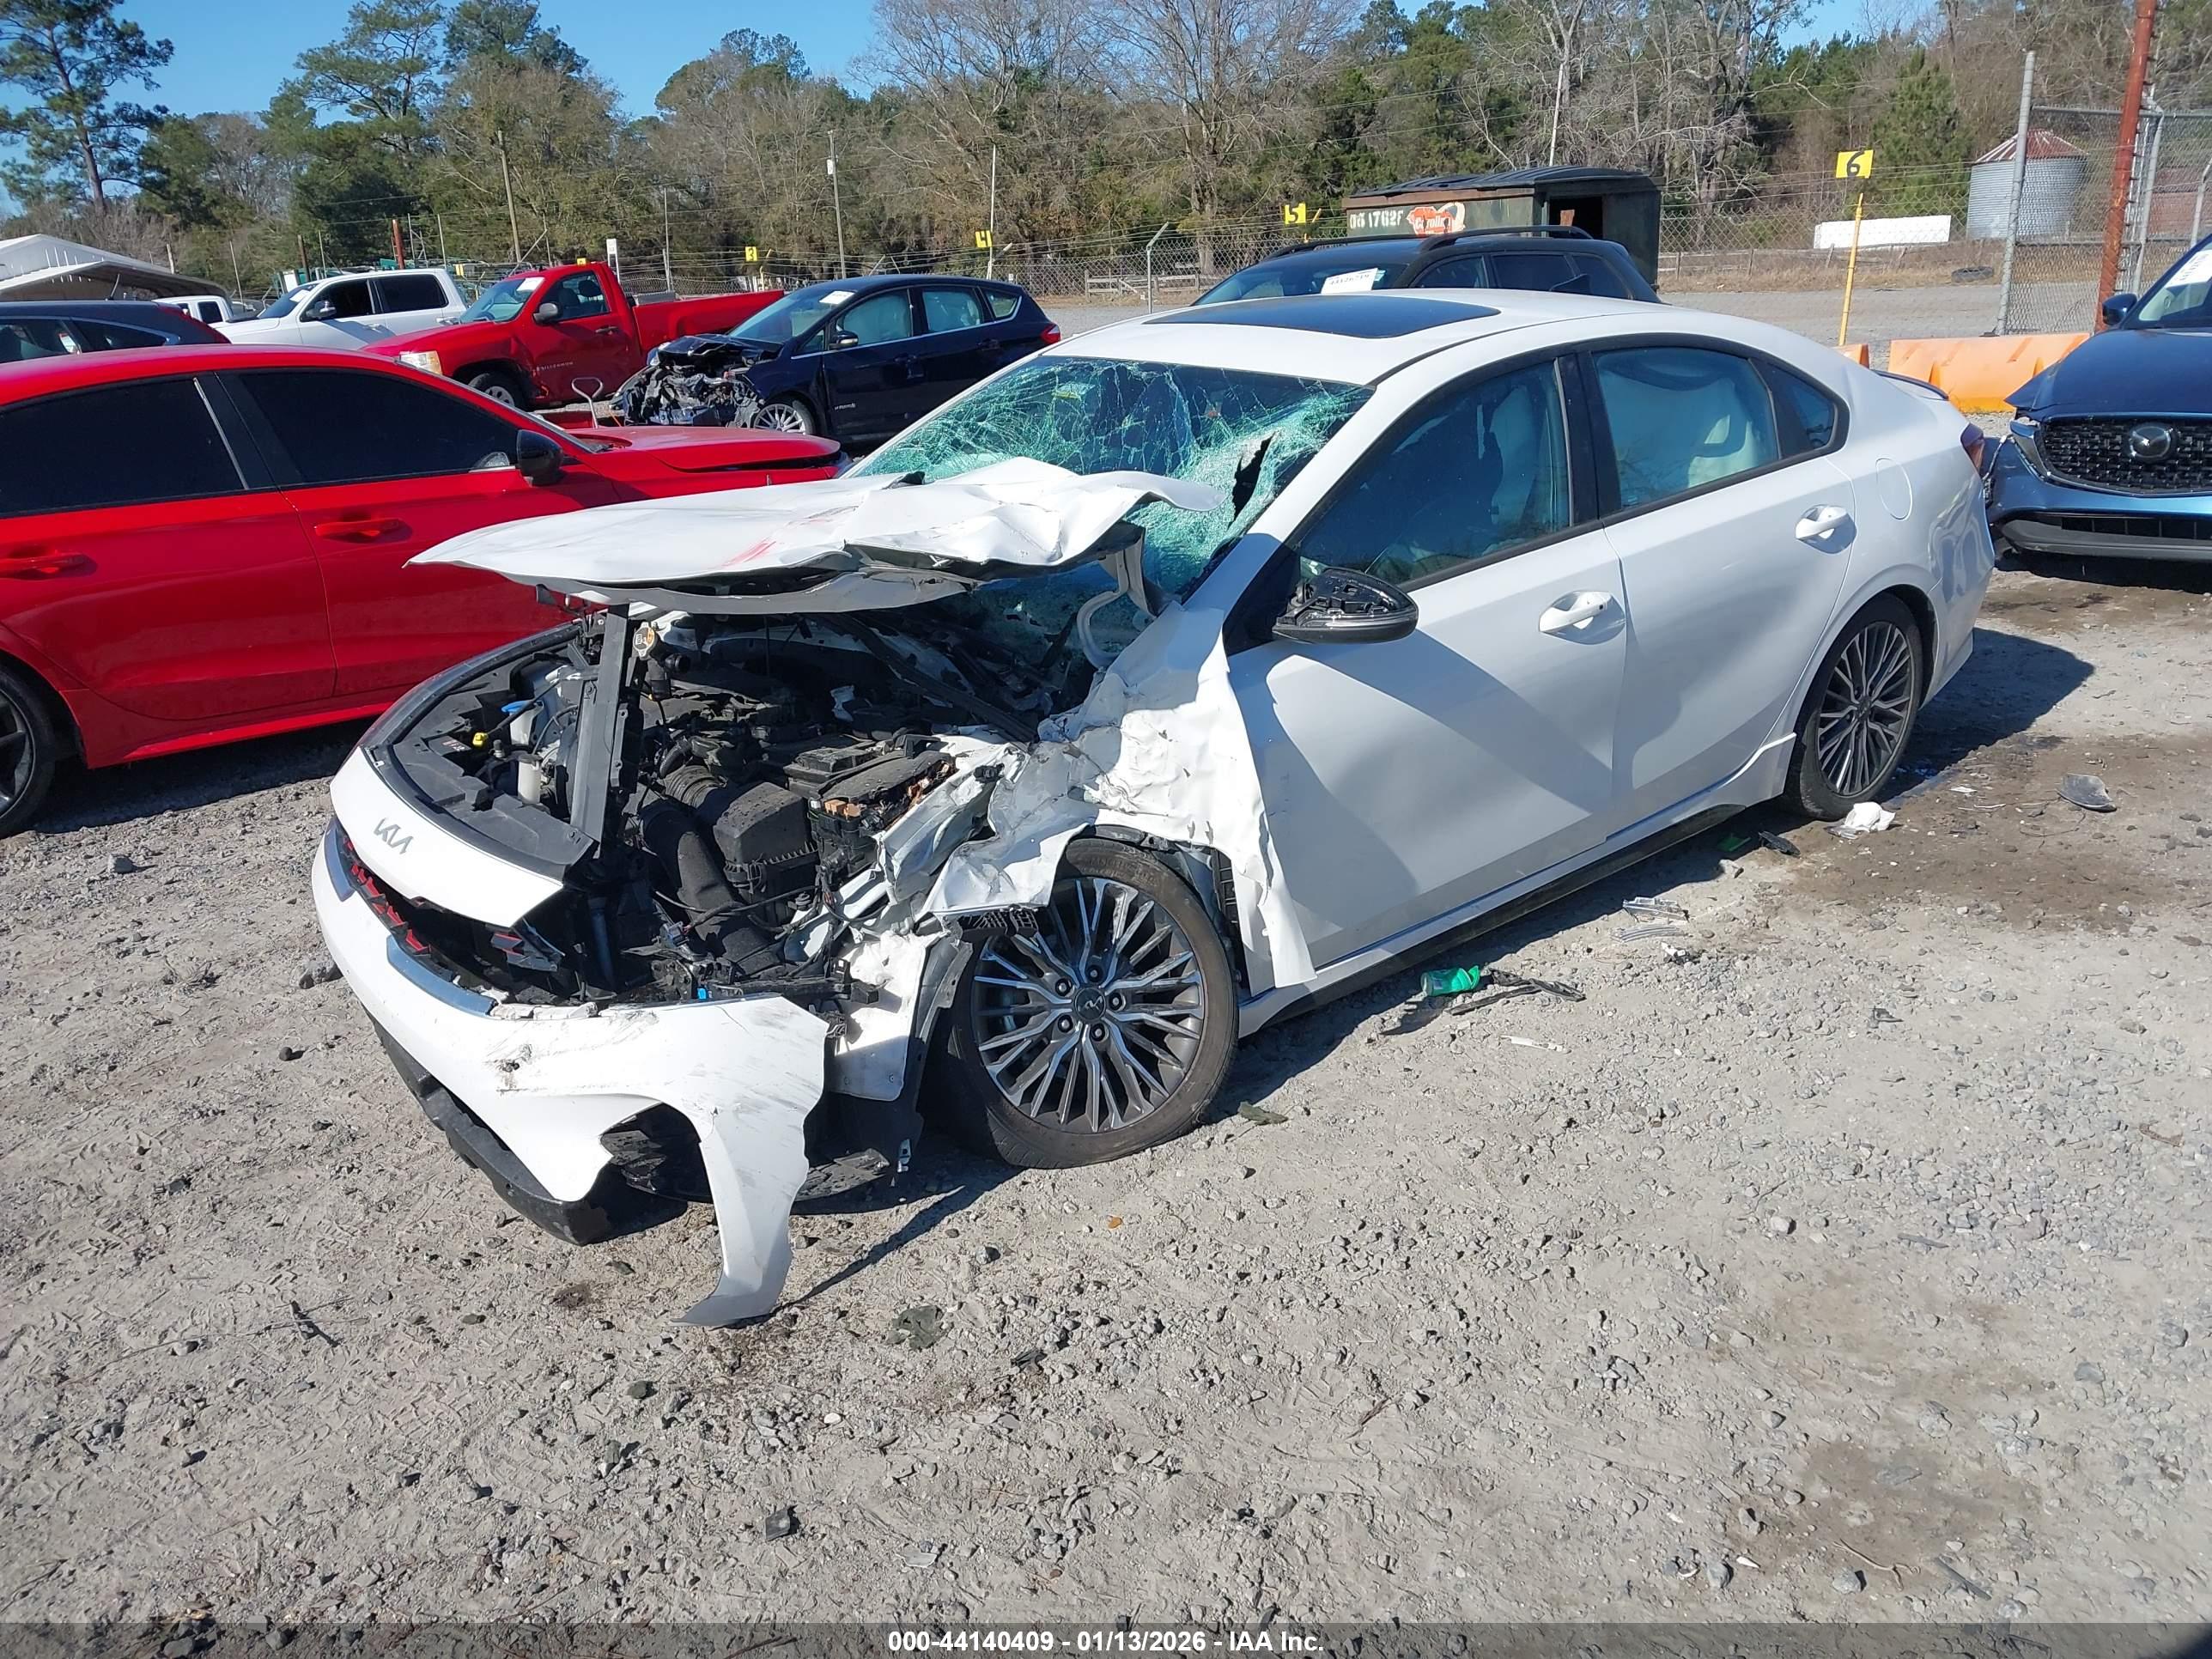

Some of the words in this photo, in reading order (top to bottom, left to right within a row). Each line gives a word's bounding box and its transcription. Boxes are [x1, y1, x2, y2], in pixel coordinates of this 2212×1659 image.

[1846, 151, 1864, 178] 6
[1288, 204, 1299, 223] 5
[979, 230, 988, 247] 4
[748, 247, 756, 261] 3
[374, 817, 414, 855] KIA
